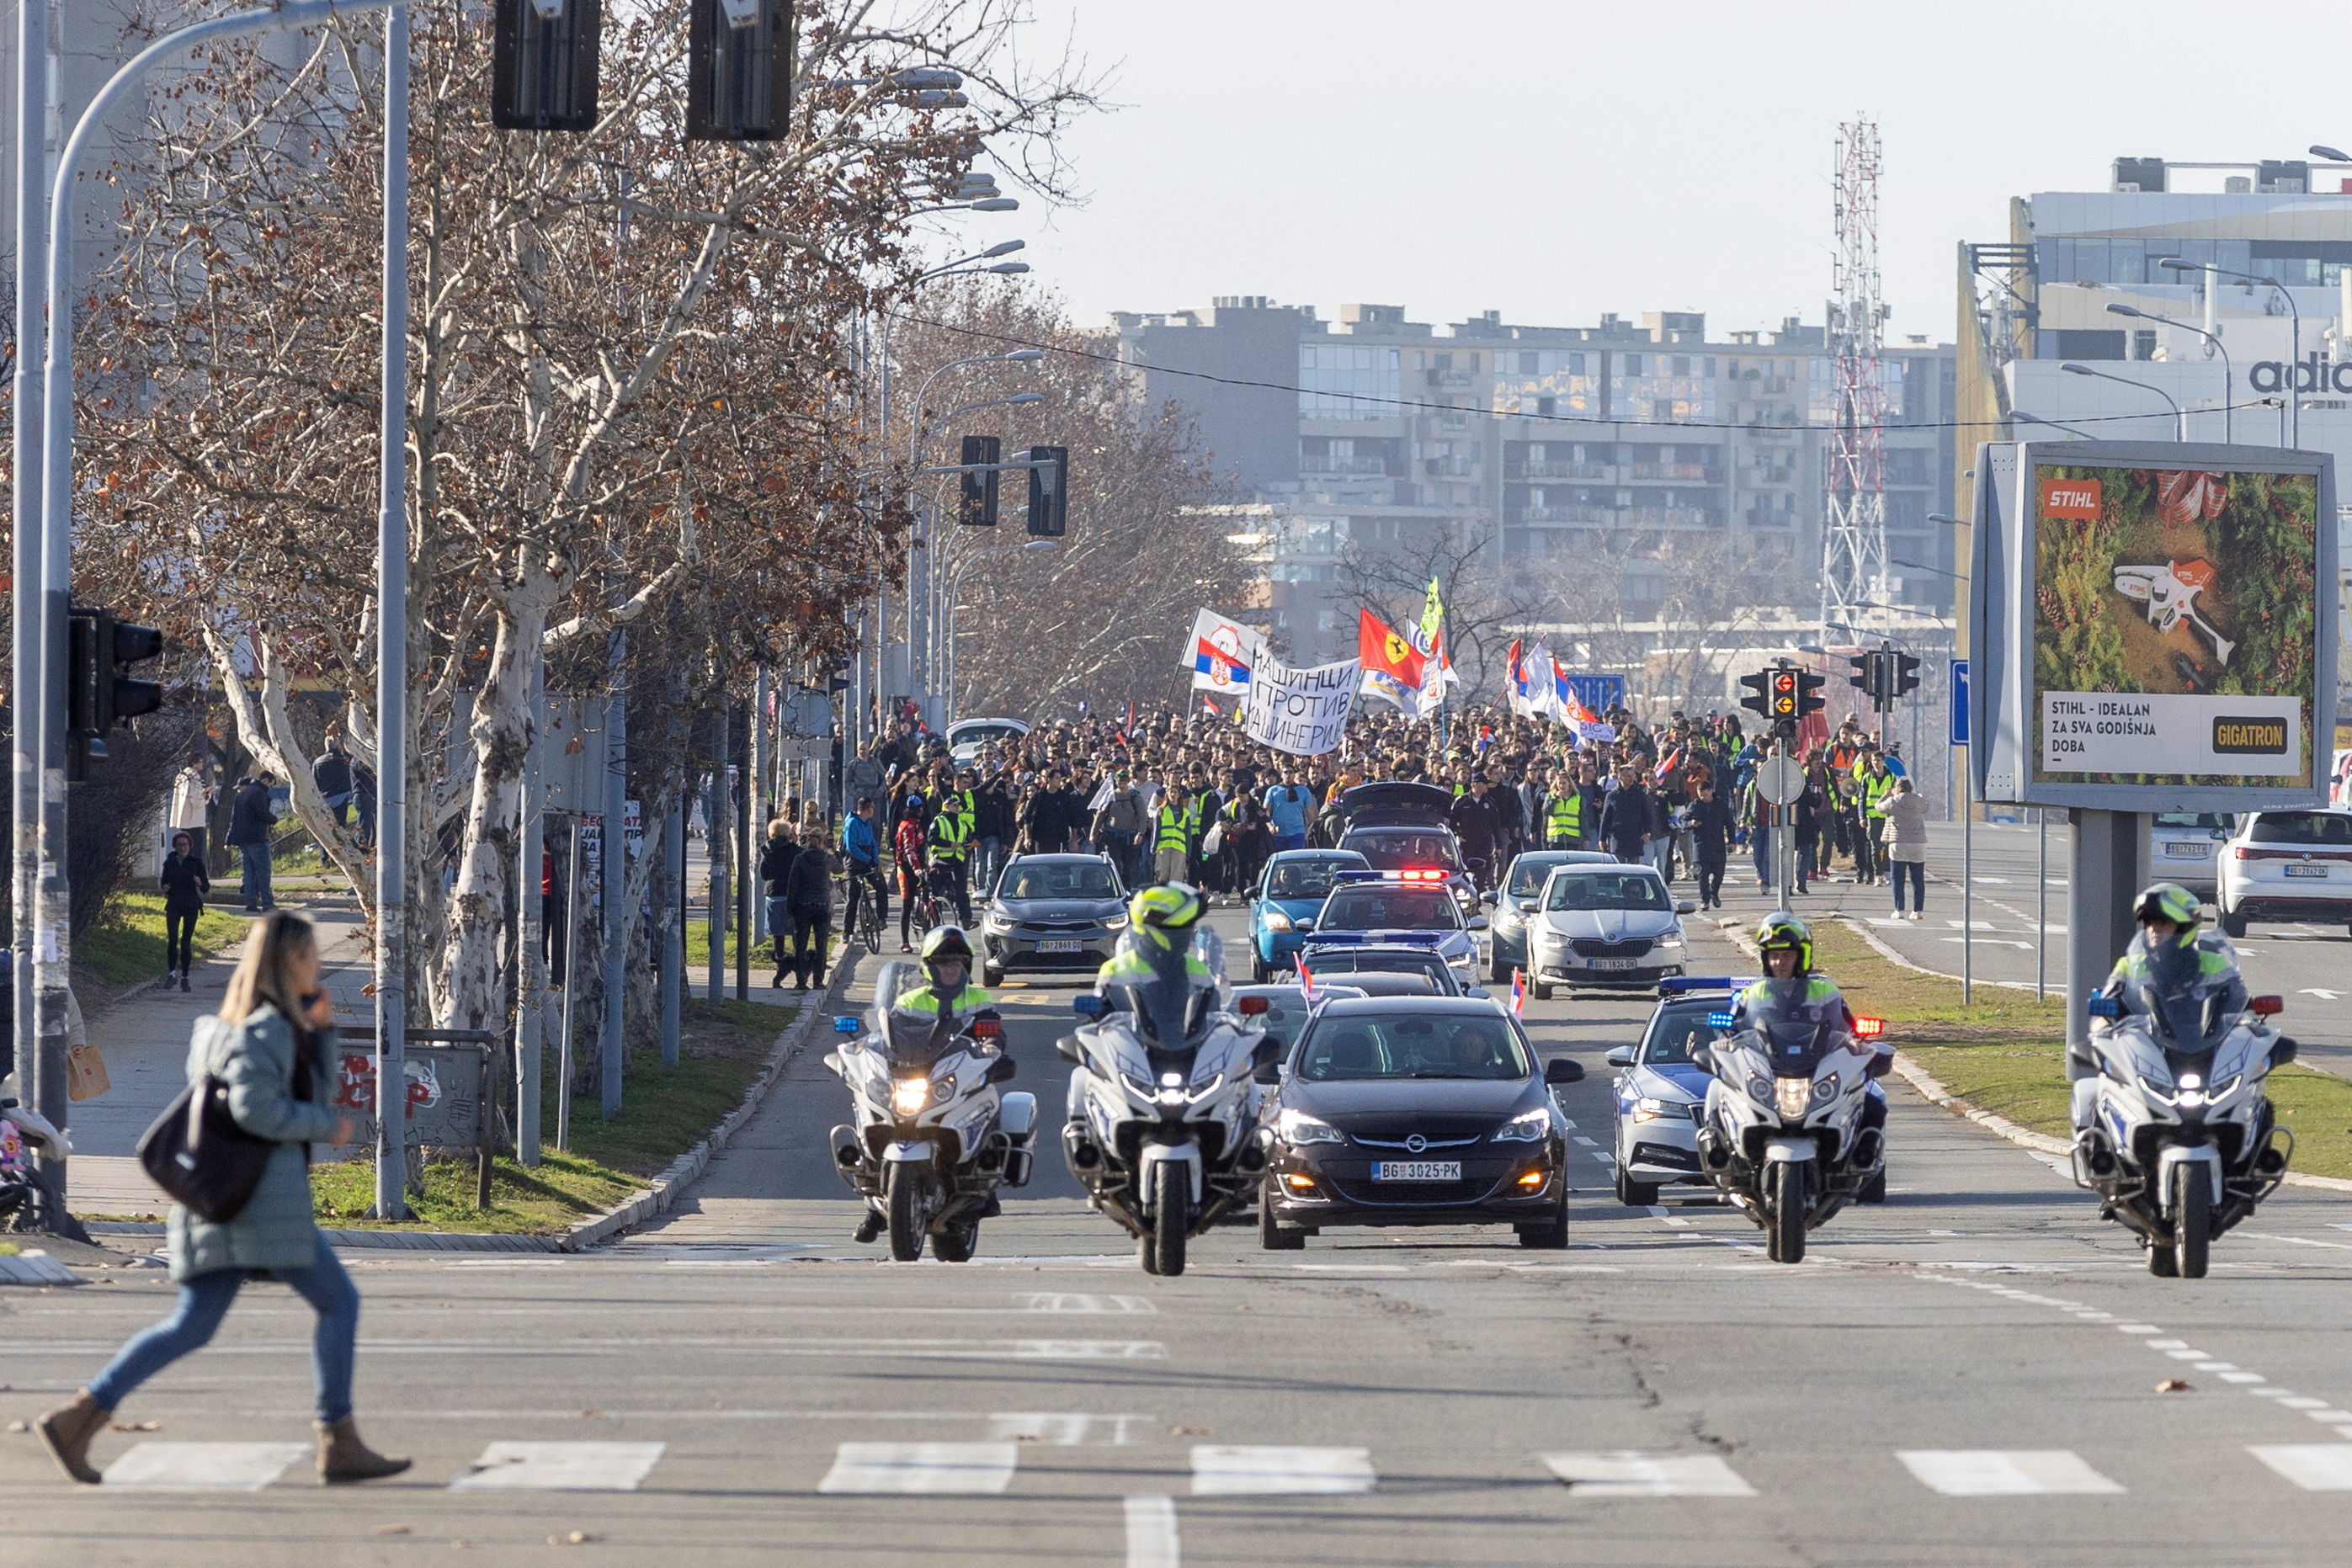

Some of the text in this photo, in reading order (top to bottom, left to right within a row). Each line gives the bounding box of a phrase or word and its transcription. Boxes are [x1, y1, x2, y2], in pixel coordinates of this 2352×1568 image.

[2050, 491, 2095, 508] STIHL
[1252, 649, 1354, 692] МАШИНЦИ
[1256, 680, 1350, 717] ПРОТИВ
[2051, 701, 2086, 715] STIHL
[2099, 703, 2150, 716] IDEALAN
[2052, 718, 2157, 735] ZA SVA GODIŠNJA
[2217, 725, 2283, 747] GIGATRON
[2052, 740, 2085, 752] DOBA
[1382, 1164, 1398, 1177] BG
